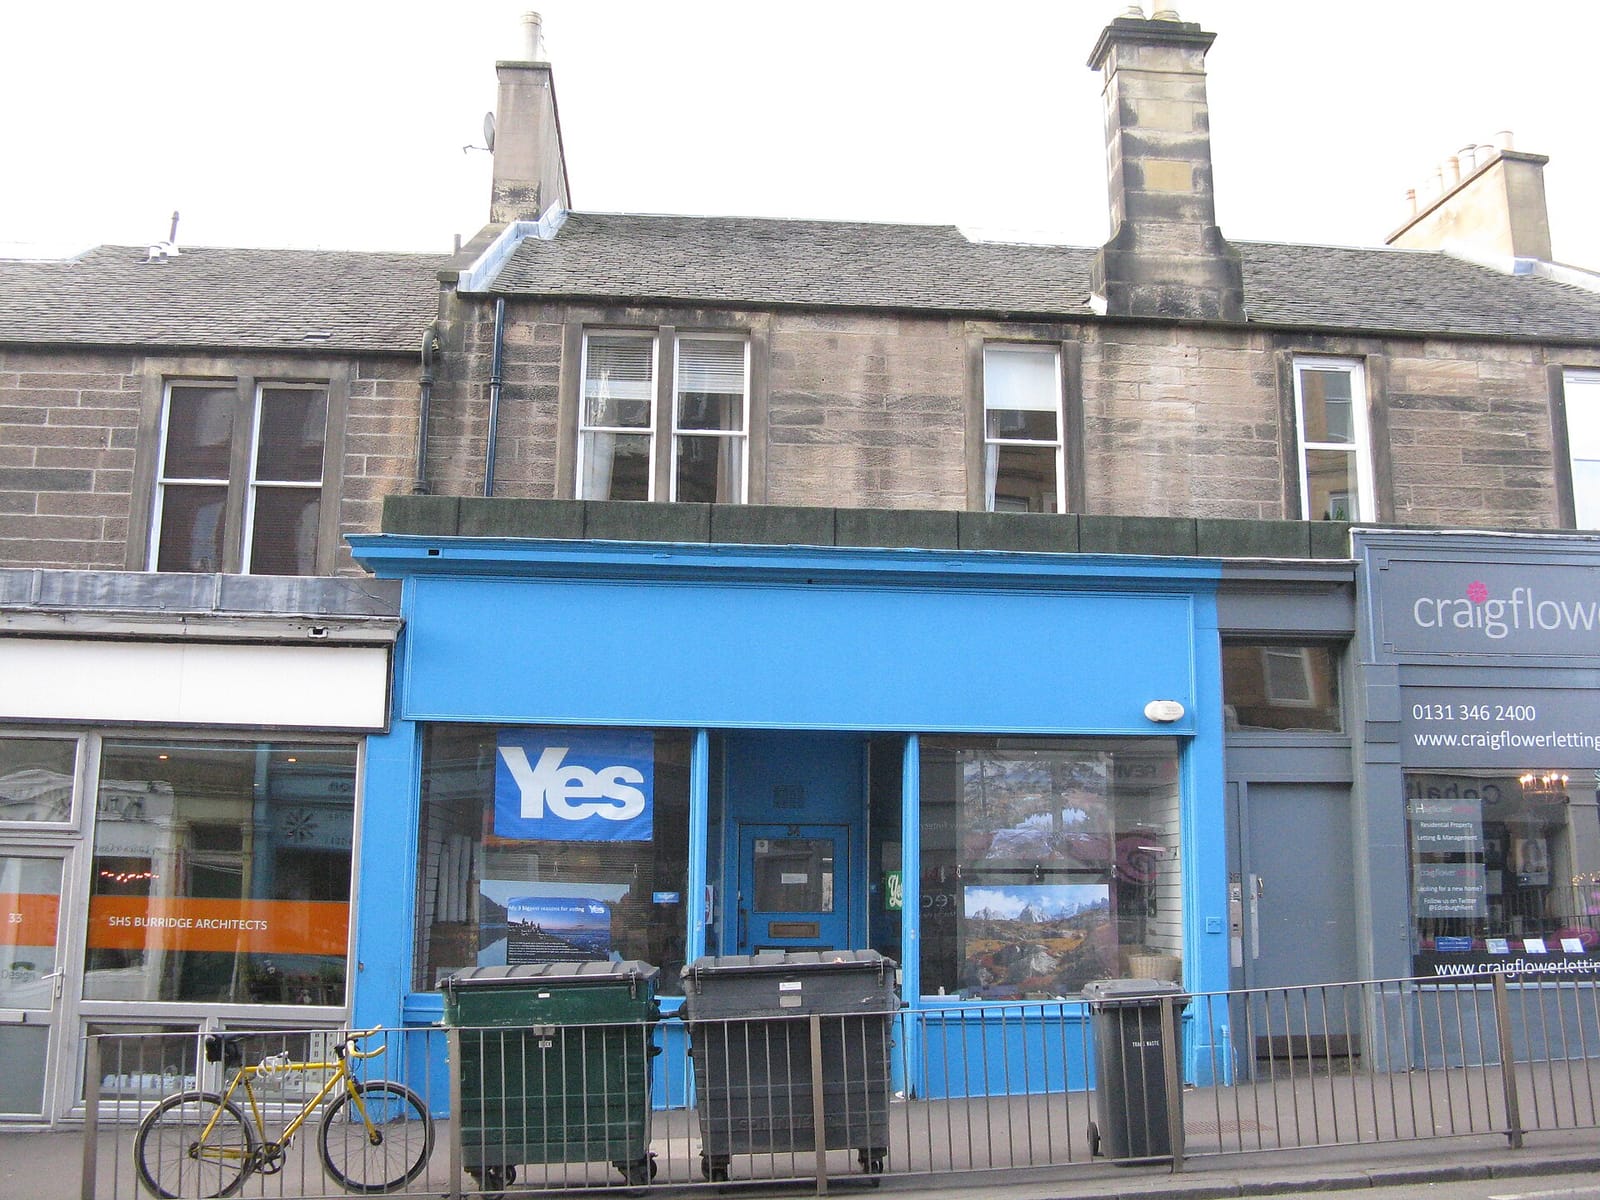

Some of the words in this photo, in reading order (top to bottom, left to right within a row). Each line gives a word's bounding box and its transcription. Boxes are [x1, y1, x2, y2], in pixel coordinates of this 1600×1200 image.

[1412, 587, 1600, 640] craigflow
[1412, 704, 1454, 721] 0131
[1459, 704, 1490, 721] 346
[1495, 705, 1536, 722] 2400
[498, 746, 645, 821] Yes
[1450, 821, 1473, 830] Property
[1436, 833, 1442, 842] &
[1442, 833, 1478, 843] Management
[1438, 885, 1447, 893] for
[589, 904, 605, 914] Yes
[8, 912, 23, 924] 33
[108, 915, 131, 928] SHS
[134, 916, 193, 930] BURRIDGE
[195, 917, 268, 931] ARCHITECTS
